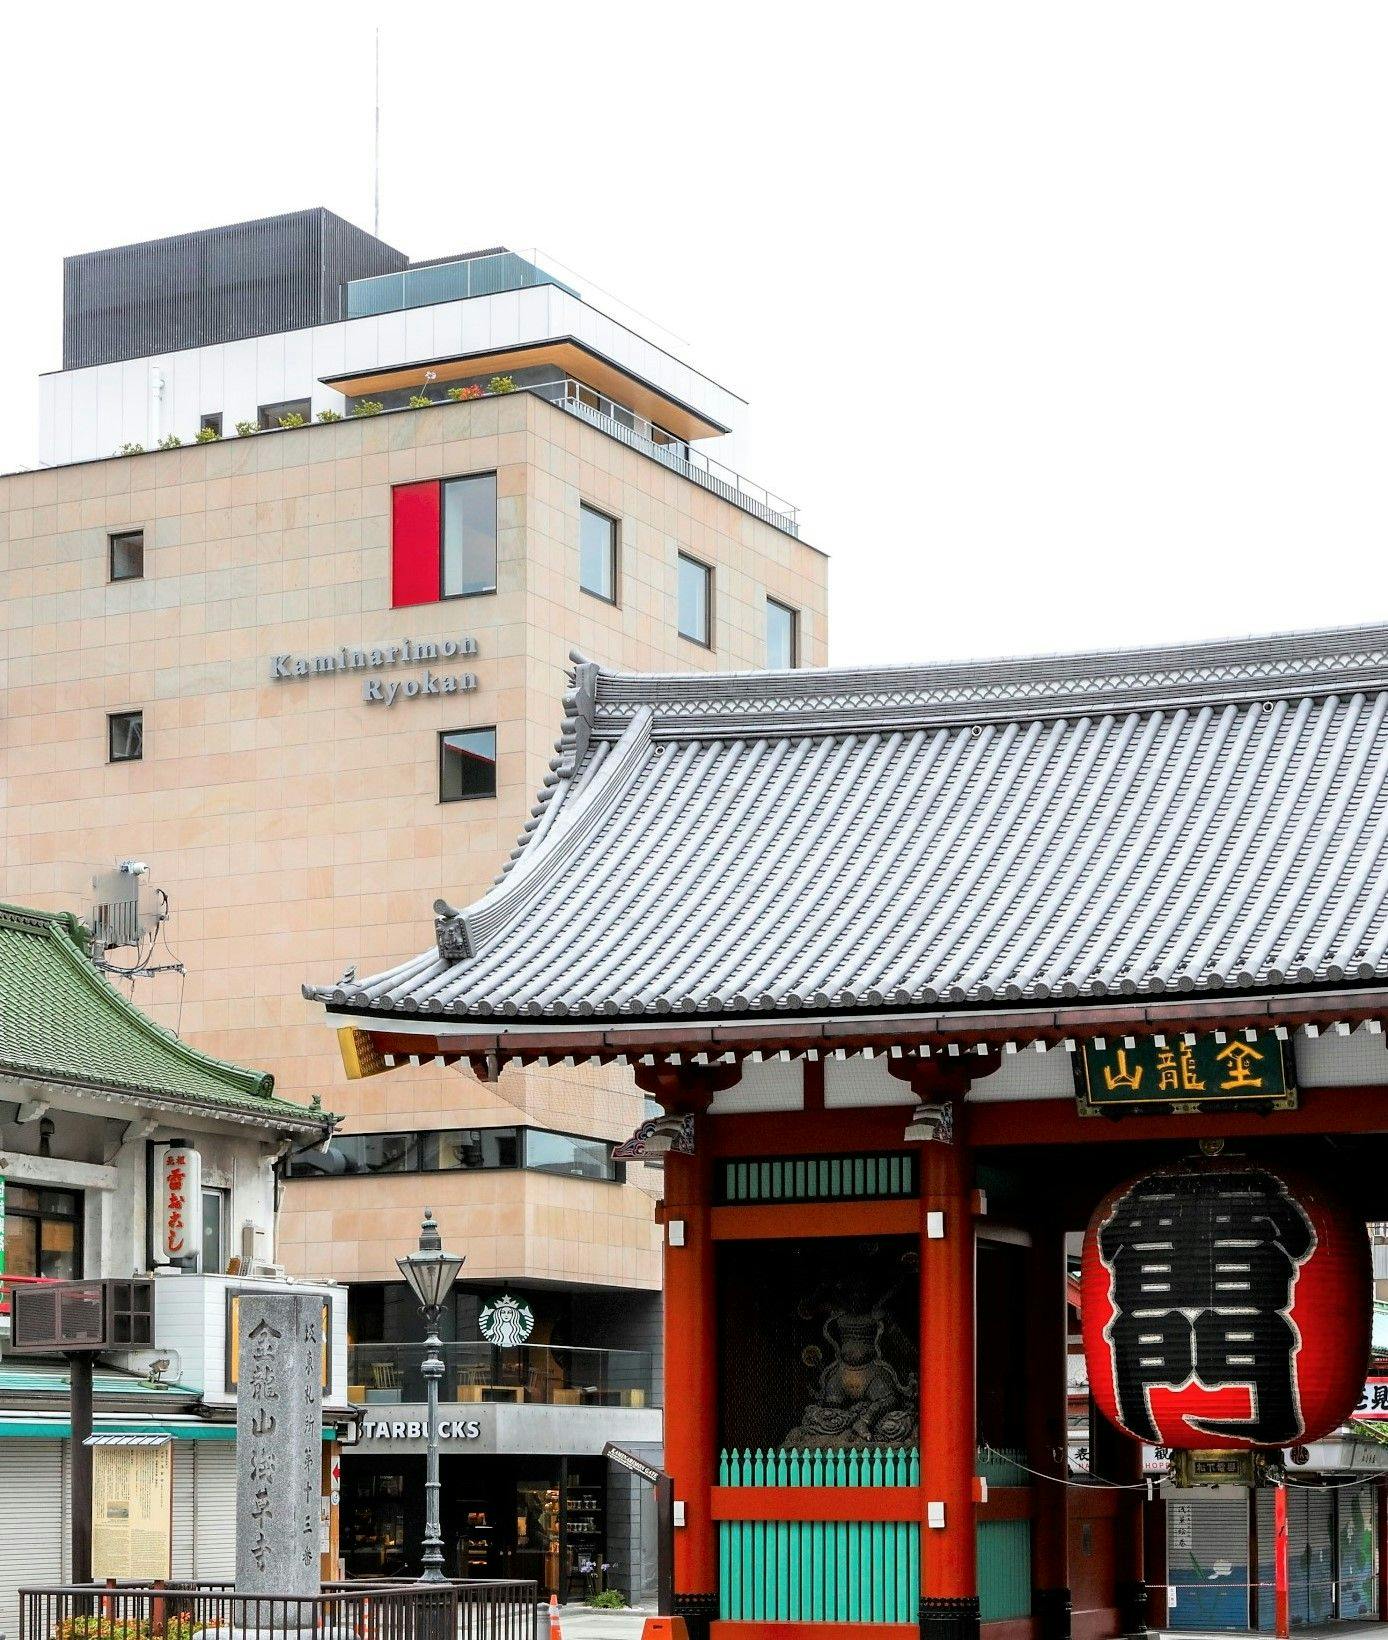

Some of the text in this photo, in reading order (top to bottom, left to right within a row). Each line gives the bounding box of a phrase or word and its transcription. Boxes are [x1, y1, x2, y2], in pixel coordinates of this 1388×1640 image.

[269, 636, 478, 680] Kaminarimon
[362, 669, 478, 708] Ryokan
[1097, 1172, 1318, 1445] 雷門
[358, 1421, 480, 1439] TARBCKS
